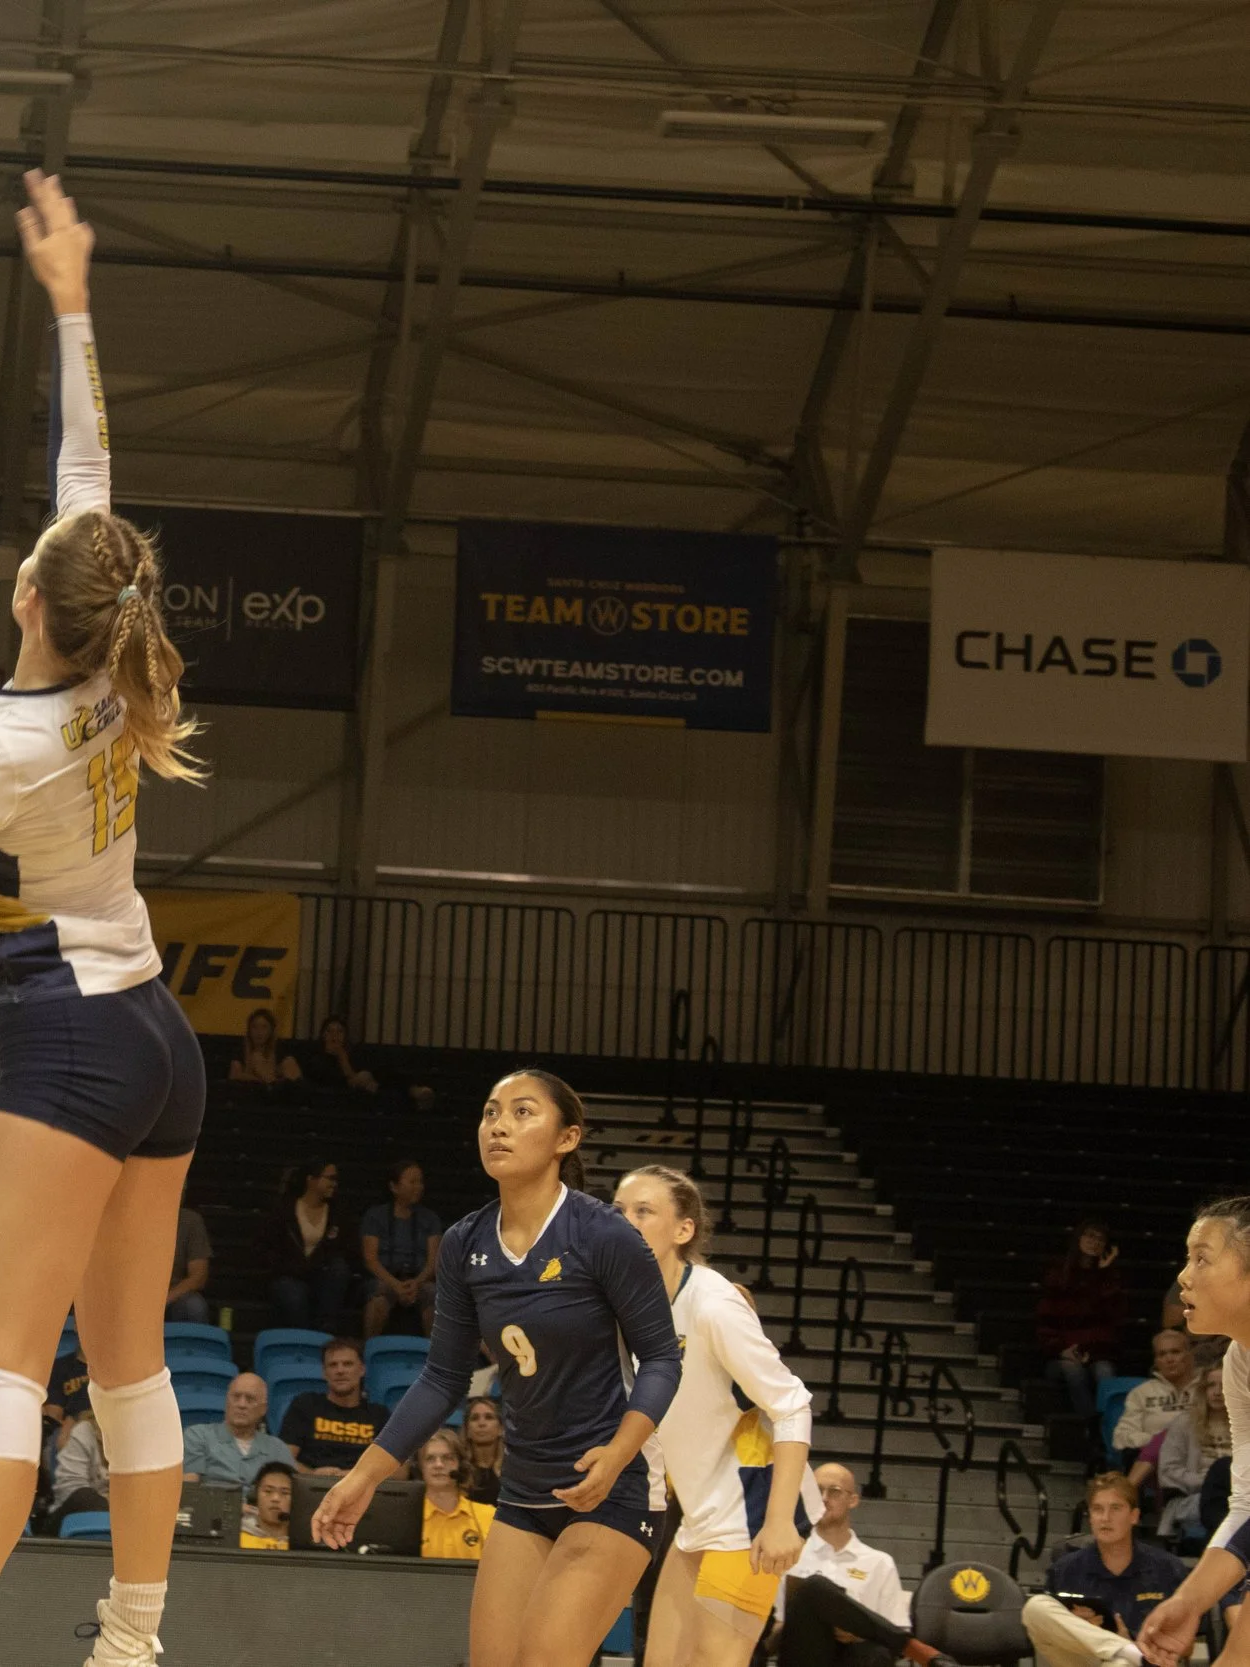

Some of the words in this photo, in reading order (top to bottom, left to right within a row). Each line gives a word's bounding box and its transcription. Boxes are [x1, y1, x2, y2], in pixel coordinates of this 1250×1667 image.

[162, 583, 218, 614] ON
[480, 592, 584, 626] TEAM
[631, 602, 750, 636] STORE
[481, 655, 745, 687] SCWTEAMSTORE.COM
[955, 631, 1158, 680] CHASE
[86, 734, 140, 857] 15
[155, 941, 289, 1000] IFE
[500, 1324, 539, 1378] 9
[315, 1416, 375, 1438] UCSC
